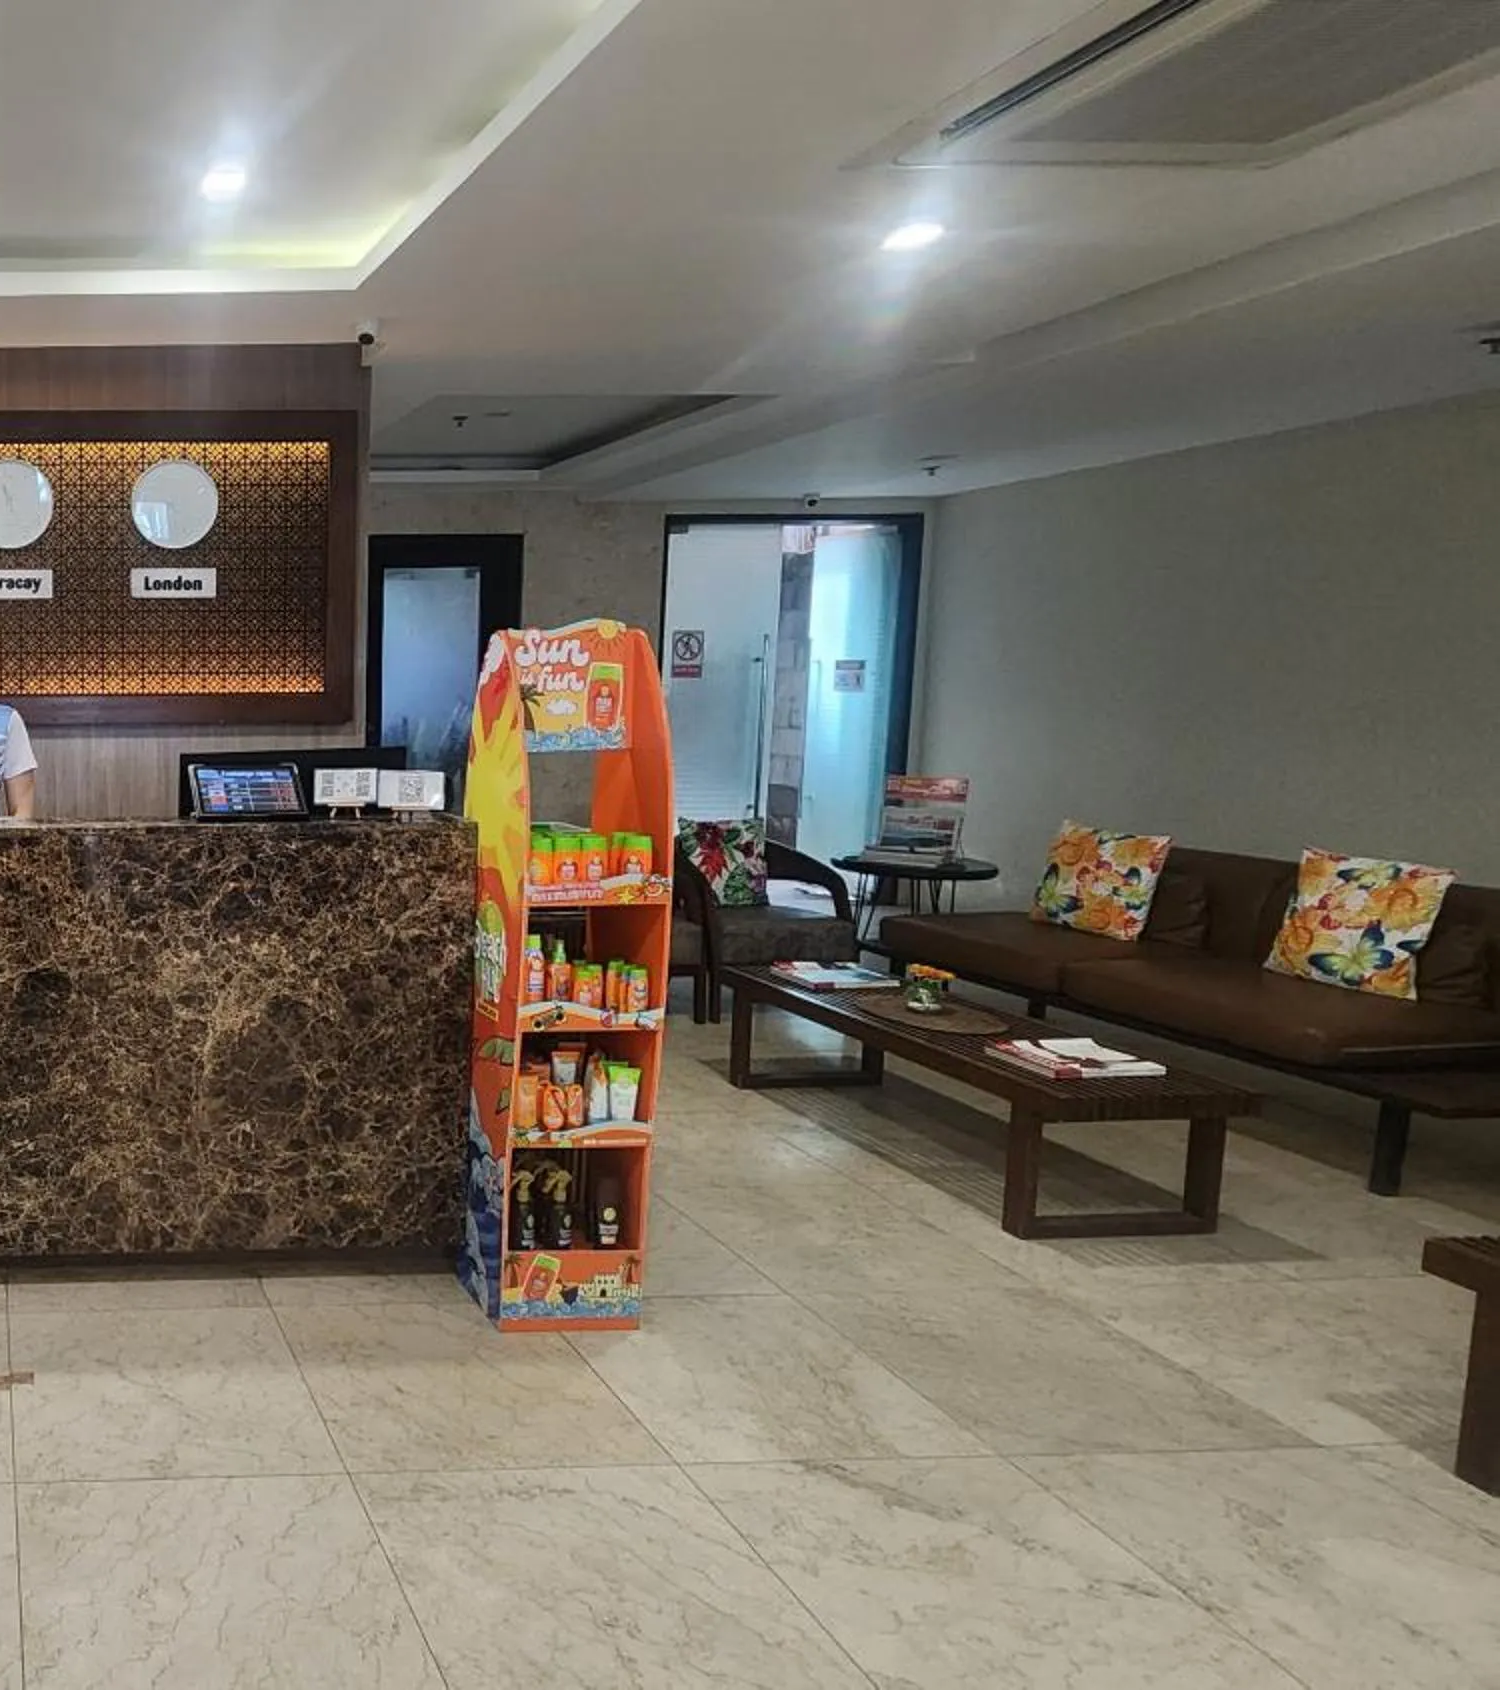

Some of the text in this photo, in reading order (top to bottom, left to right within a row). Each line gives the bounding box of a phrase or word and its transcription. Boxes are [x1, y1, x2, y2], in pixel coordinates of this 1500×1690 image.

[144, 575, 203, 591] London
[515, 628, 590, 667] Sun
[536, 665, 584, 692] fun
